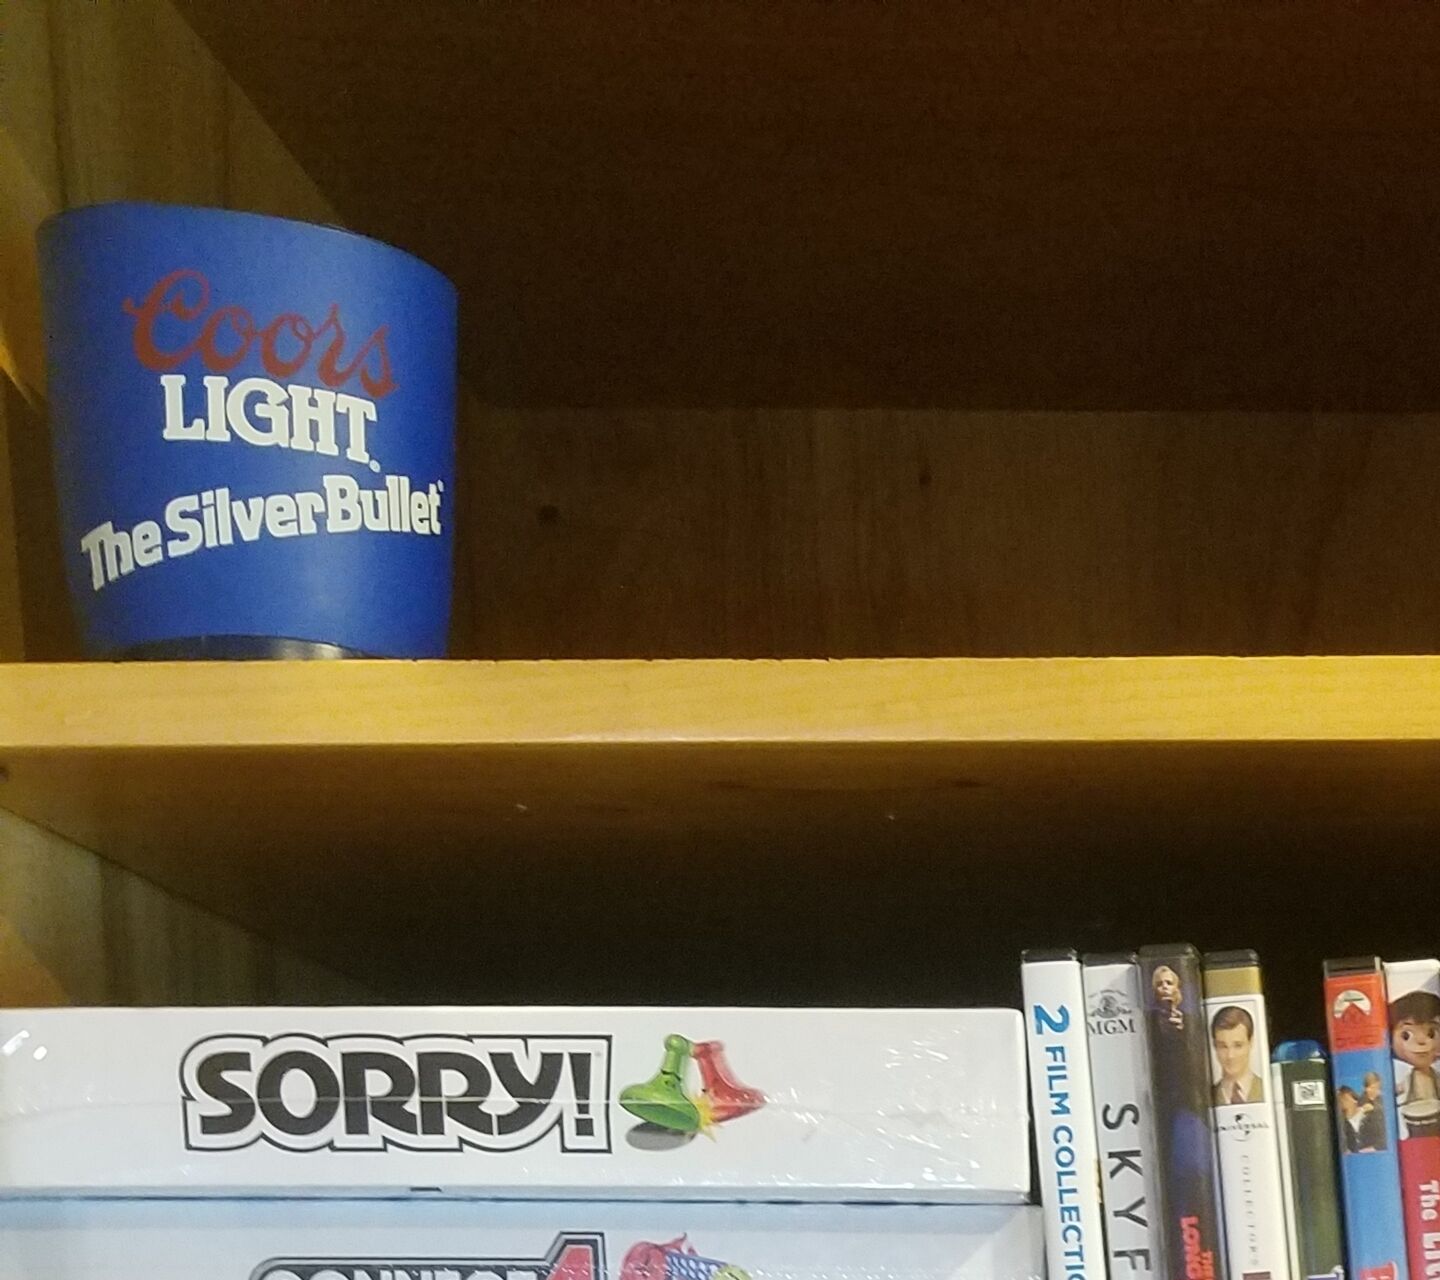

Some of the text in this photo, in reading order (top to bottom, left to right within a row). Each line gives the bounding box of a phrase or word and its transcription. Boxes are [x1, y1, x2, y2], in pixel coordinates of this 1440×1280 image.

[122, 269, 399, 398] Coors
[81, 474, 442, 591] The Silver Bullet
[1033, 1004, 1070, 1035] 2
[190, 1048, 597, 1140] SORRY!
[1045, 1045, 1071, 1116] FILM
[1419, 1179, 1440, 1220] The
[1180, 1215, 1203, 1279] LONG
[1200, 1250, 1214, 1279] THE
